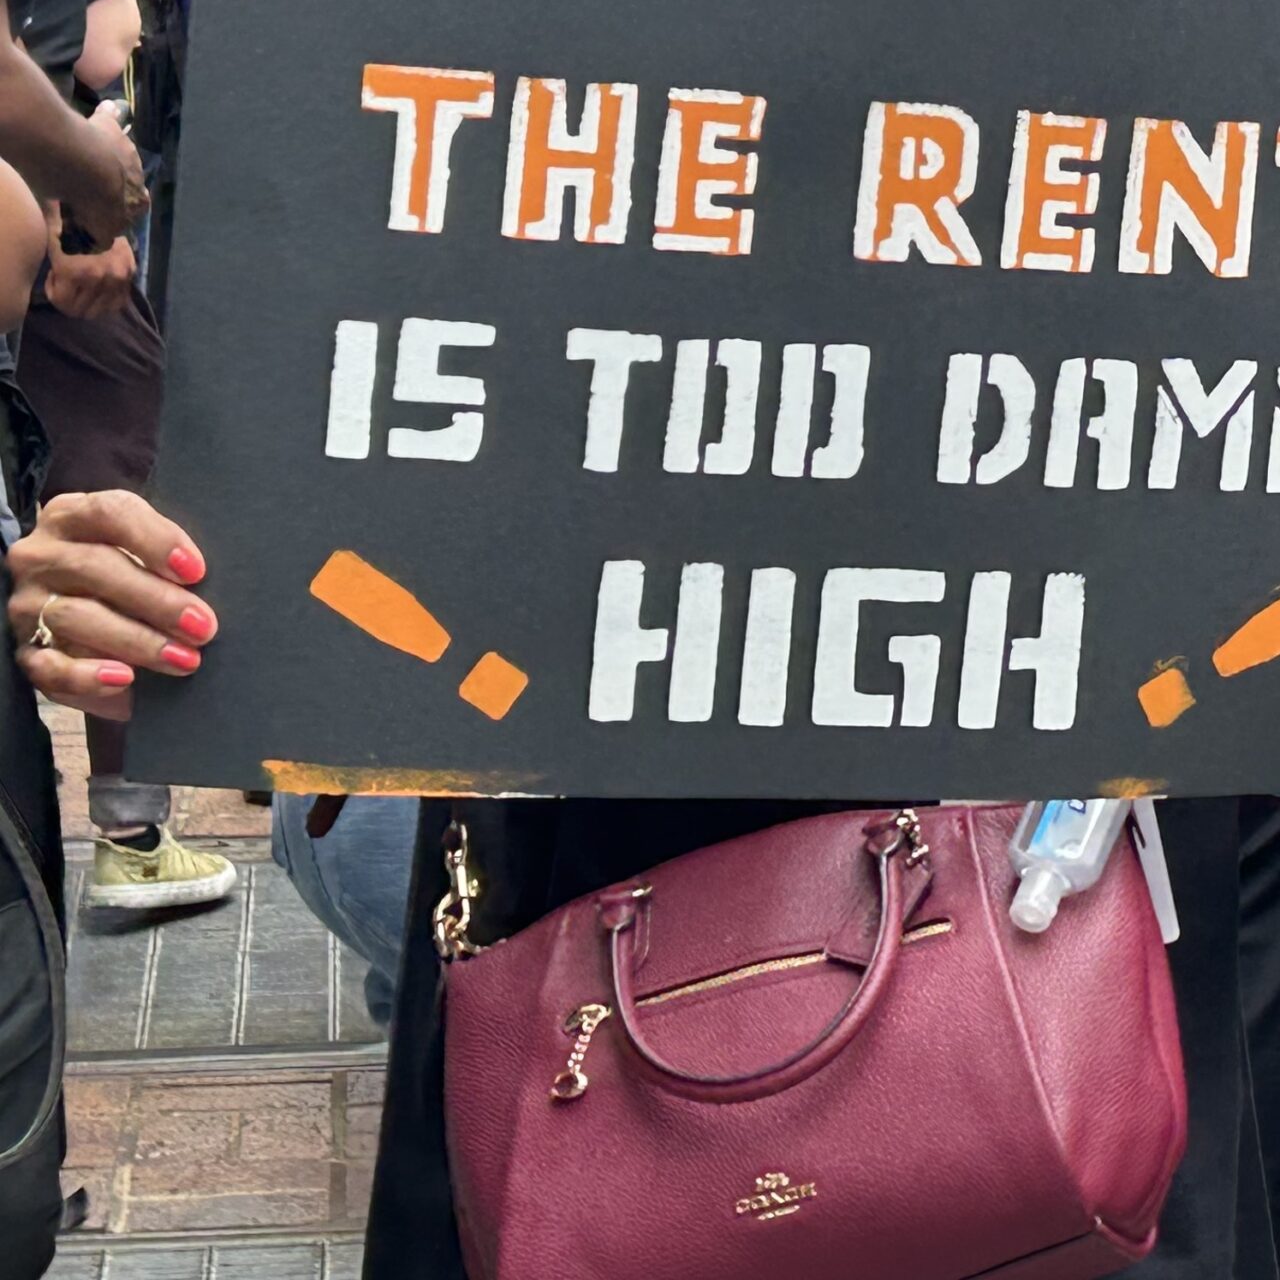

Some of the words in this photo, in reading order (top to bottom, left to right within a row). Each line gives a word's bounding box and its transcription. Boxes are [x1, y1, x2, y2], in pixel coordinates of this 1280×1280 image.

[361, 62, 767, 256] THE
[325, 317, 496, 463] IS
[566, 327, 871, 479] TOO
[588, 559, 1086, 731] HIGH
[736, 1182, 818, 1214] COACH
